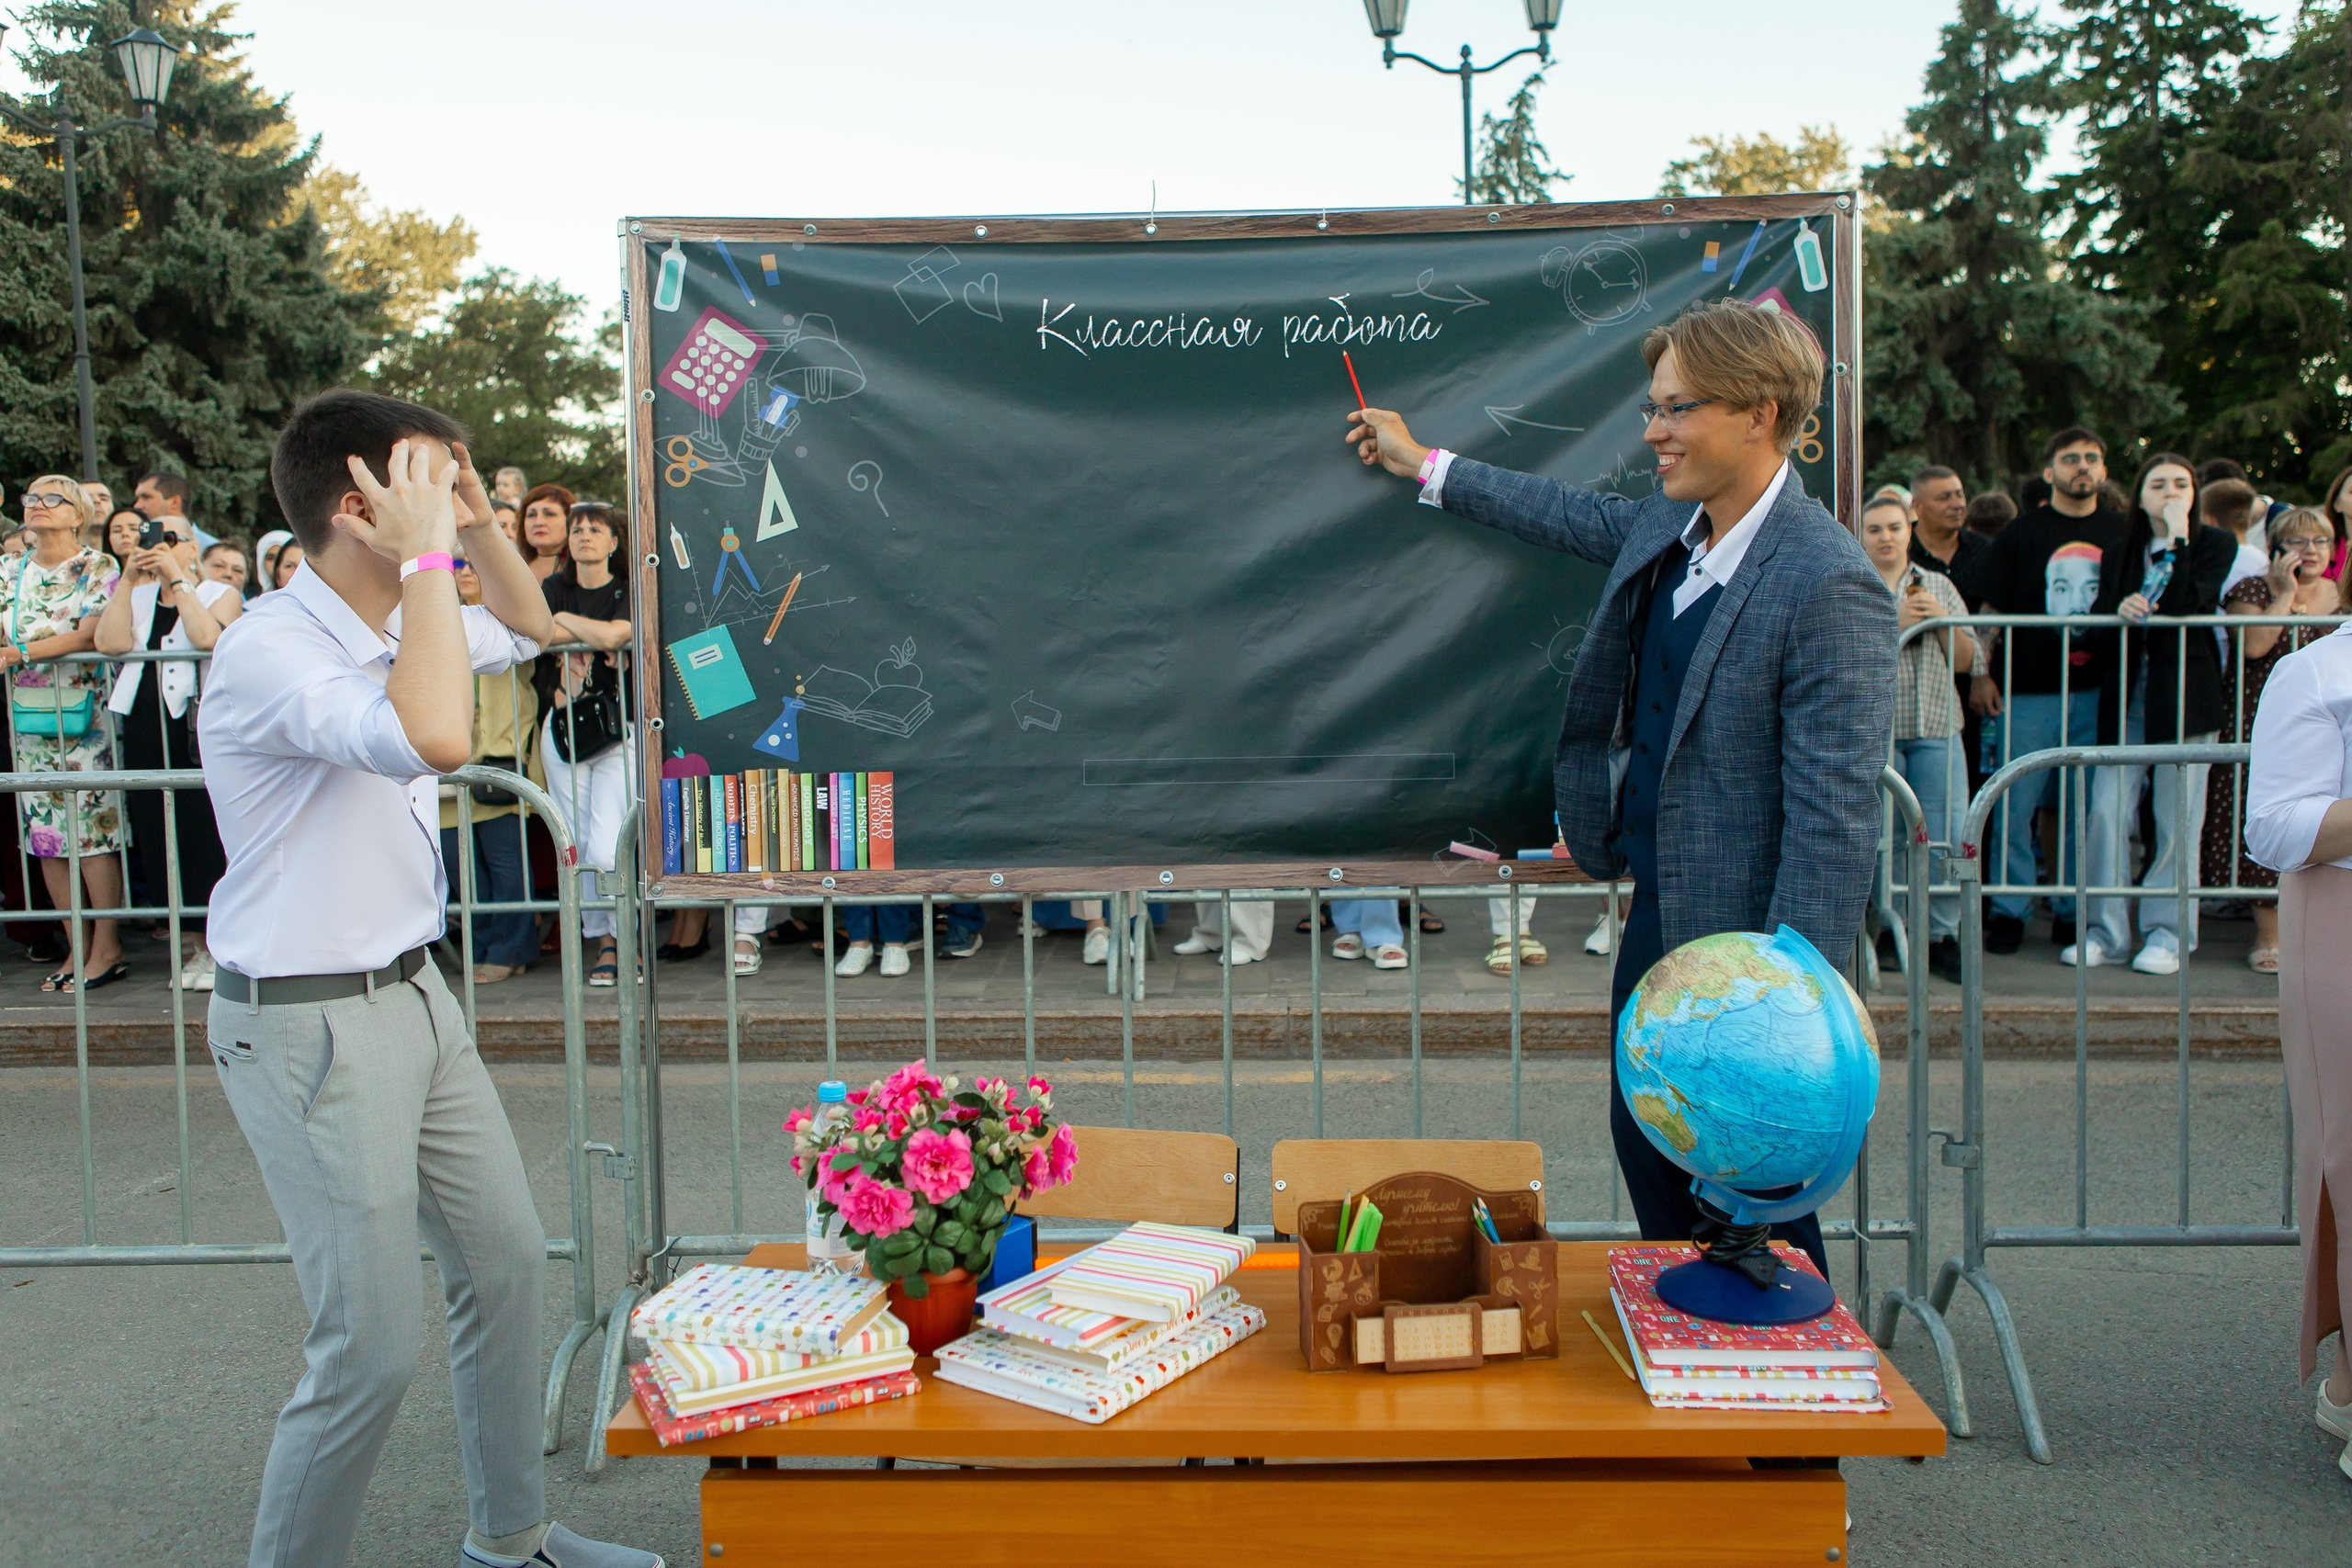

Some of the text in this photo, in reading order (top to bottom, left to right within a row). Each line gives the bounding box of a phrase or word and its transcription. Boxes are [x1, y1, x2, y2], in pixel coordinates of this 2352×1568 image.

[1036, 293, 1442, 360] Классная работа
[749, 784, 758, 834] Chemistry
[803, 785, 812, 846] SOCIOLOGY
[817, 787, 828, 809] LAW
[842, 790, 852, 840] MEDICINE
[857, 796, 867, 843] PHYSICS
[870, 784, 881, 839] HISTORY
[881, 784, 892, 839] WORLD
[667, 827, 676, 855] History
[727, 782, 737, 865] MODERN POLITICS
[1634, 1258, 1652, 1266] ONE
[1659, 1314, 1680, 1323] ONE
